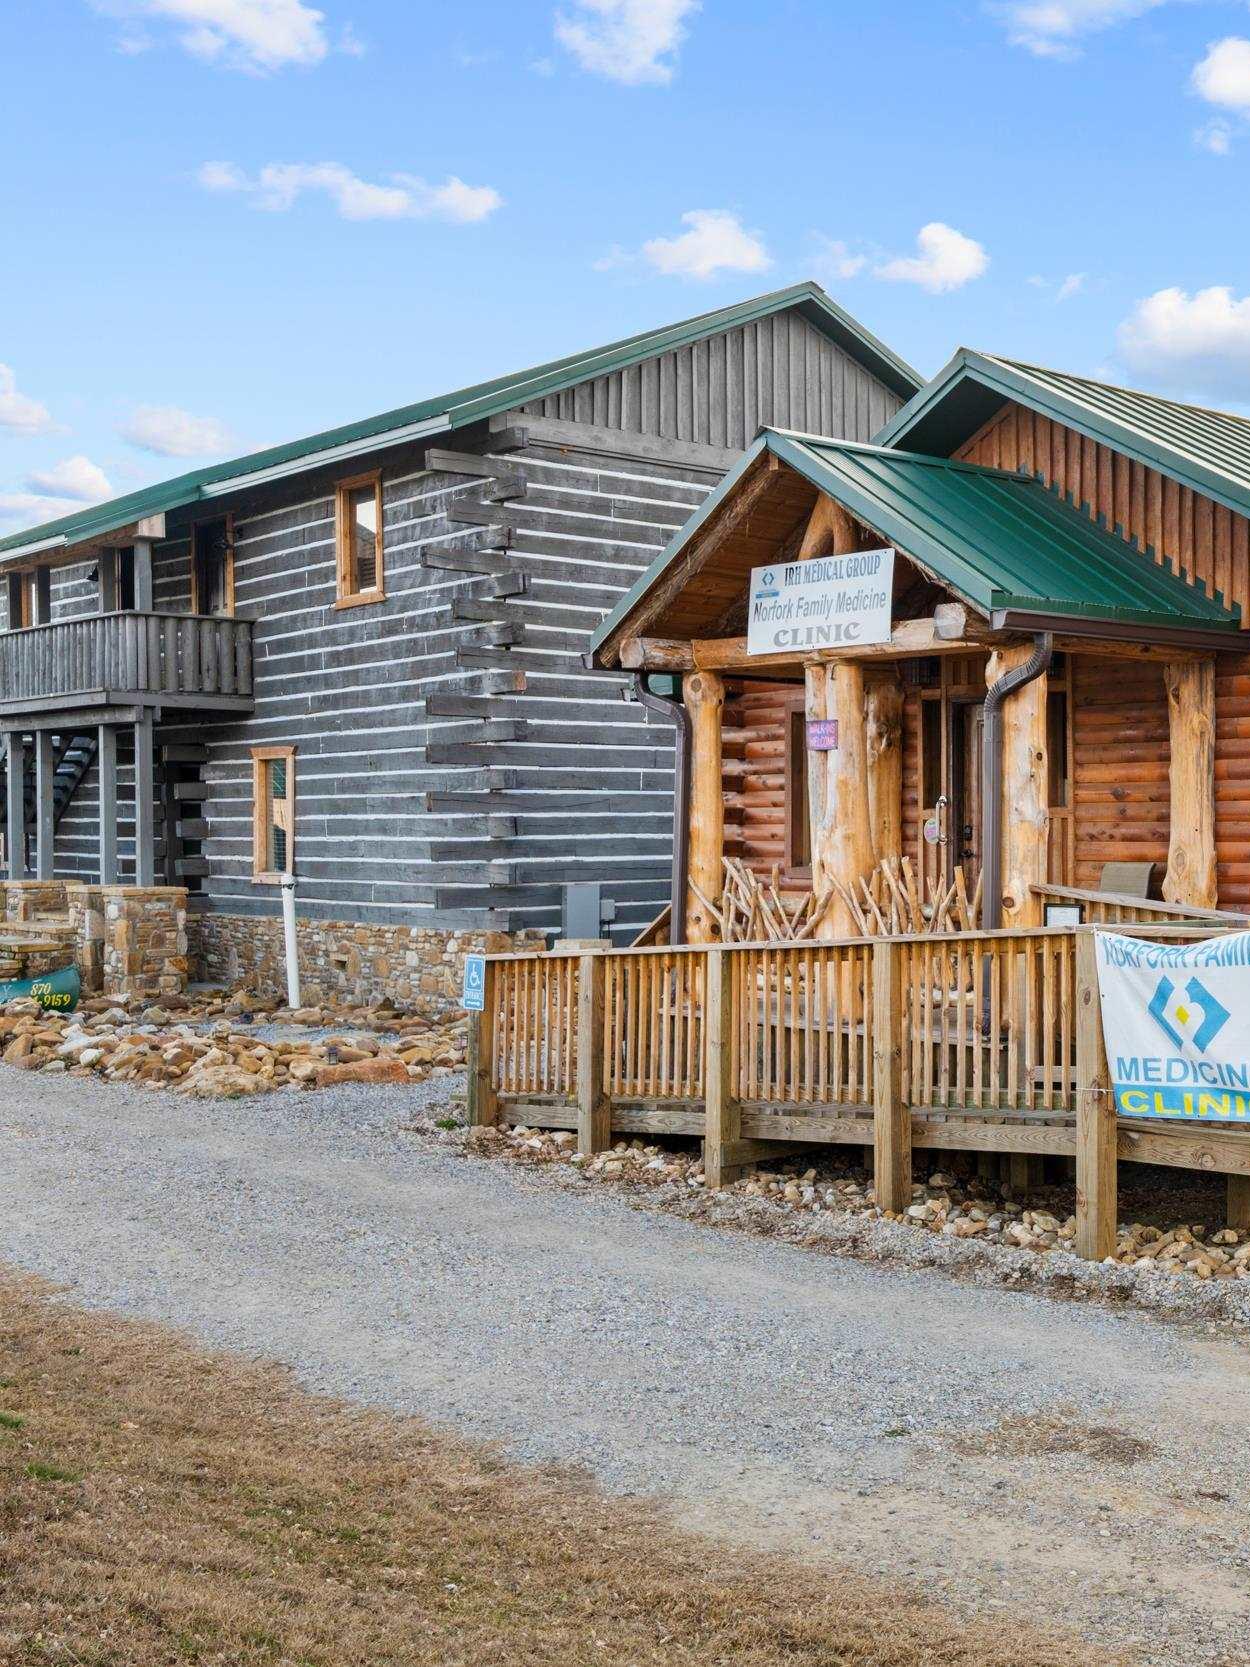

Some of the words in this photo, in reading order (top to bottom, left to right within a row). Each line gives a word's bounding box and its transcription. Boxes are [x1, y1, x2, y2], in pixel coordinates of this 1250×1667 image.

[784, 566, 801, 587] IRH
[803, 560, 844, 584] MEDICAL
[846, 554, 881, 578] GROUP
[753, 597, 793, 623] Norfork
[795, 591, 834, 620] Family
[835, 588, 886, 614] Medicine
[773, 622, 861, 648] CLINIC
[1103, 938, 1191, 969] NORFORK
[30, 982, 51, 995] 870
